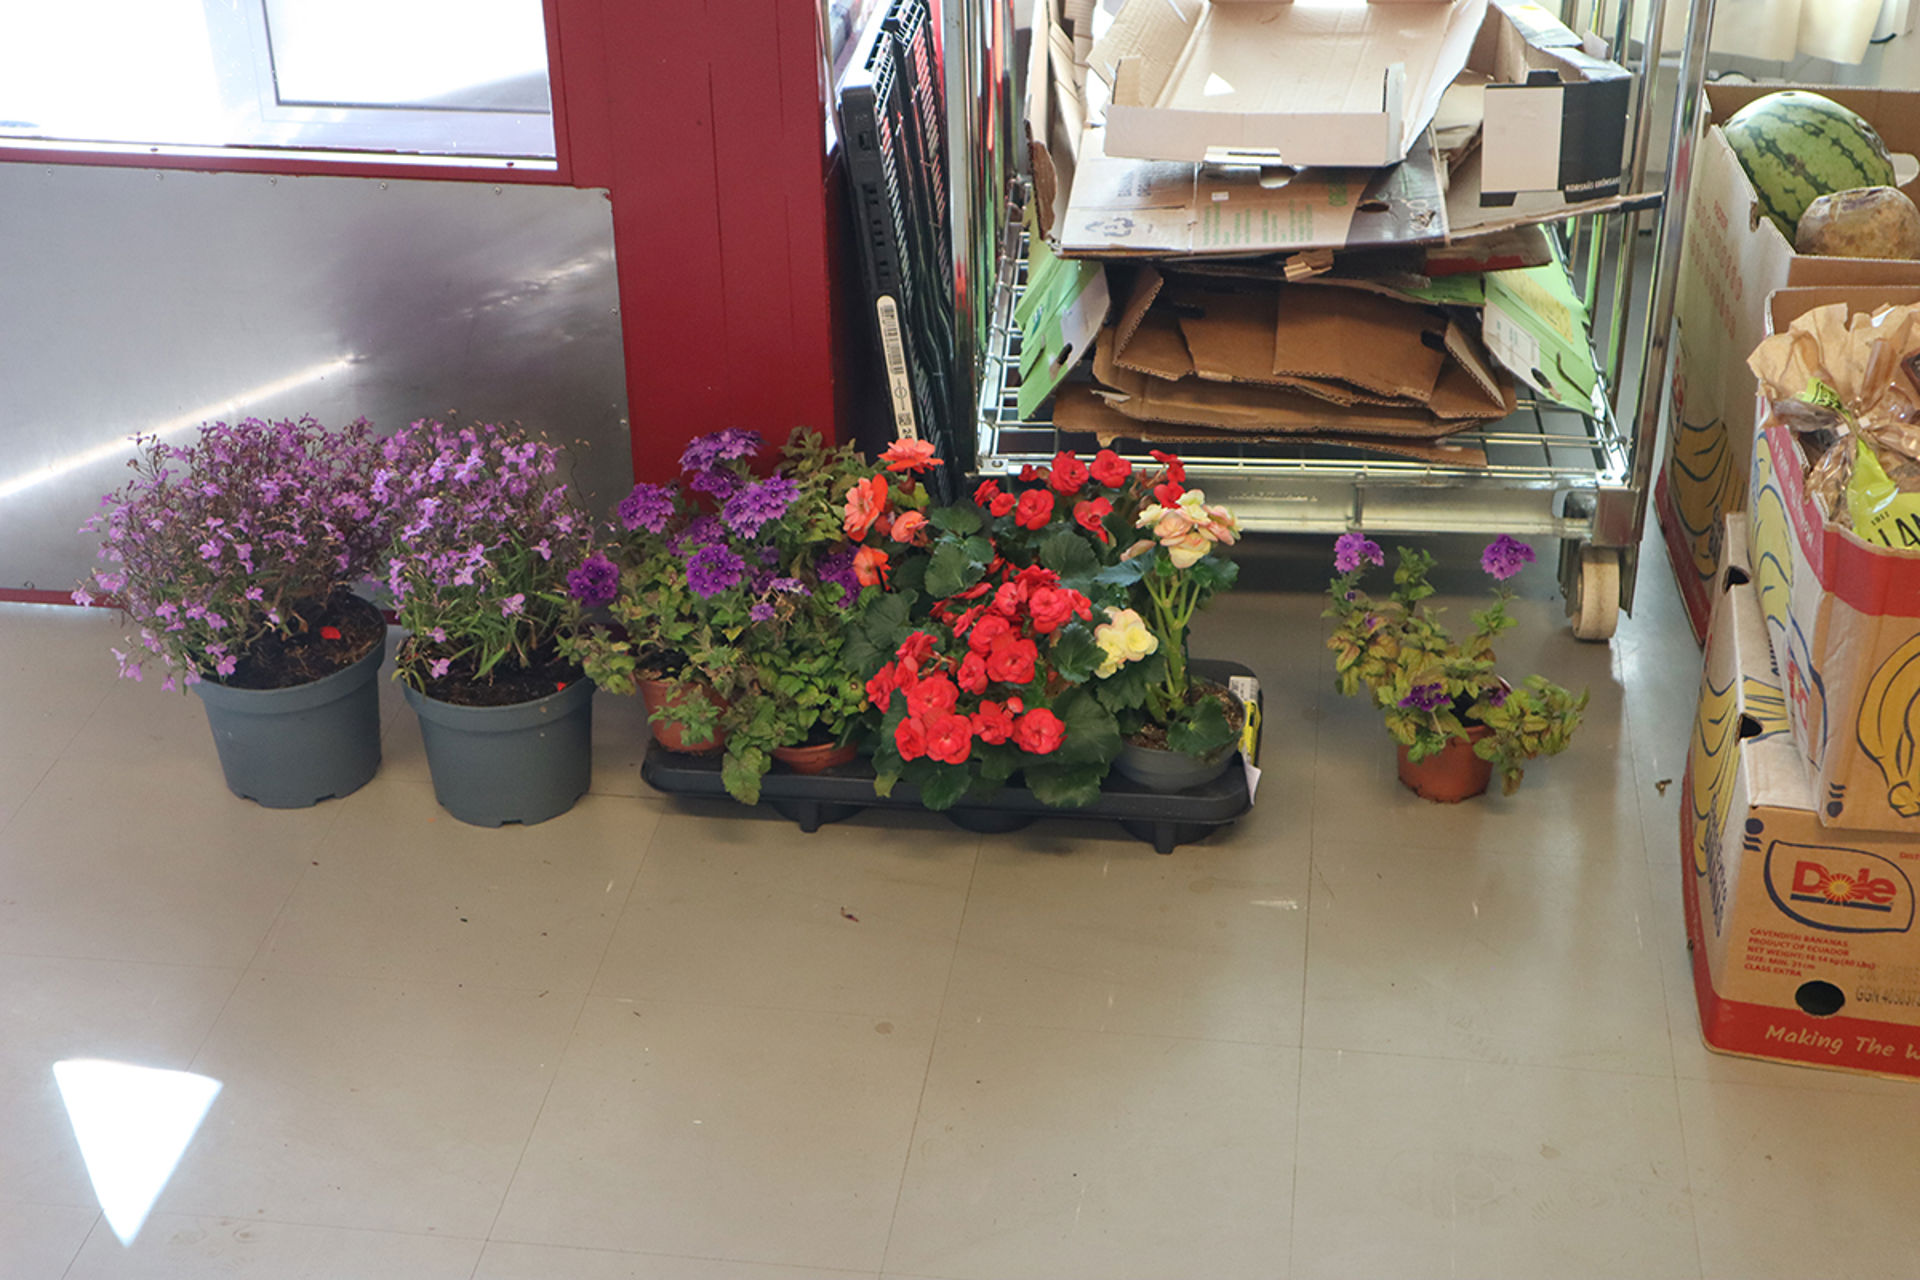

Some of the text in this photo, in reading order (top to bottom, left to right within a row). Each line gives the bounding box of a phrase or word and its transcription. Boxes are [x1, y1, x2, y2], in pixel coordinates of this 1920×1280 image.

[1791, 860, 1897, 905] Dole
[1748, 937, 1791, 948] PRODUCT
[1807, 945, 1849, 956] ECUADOR
[1804, 936, 1848, 947] BANANAS
[1747, 946, 1764, 954] NET
[1744, 963, 1802, 977] CLASS EXTRA
[1765, 1025, 1844, 1055] Making
[1856, 1036, 1896, 1057] The
